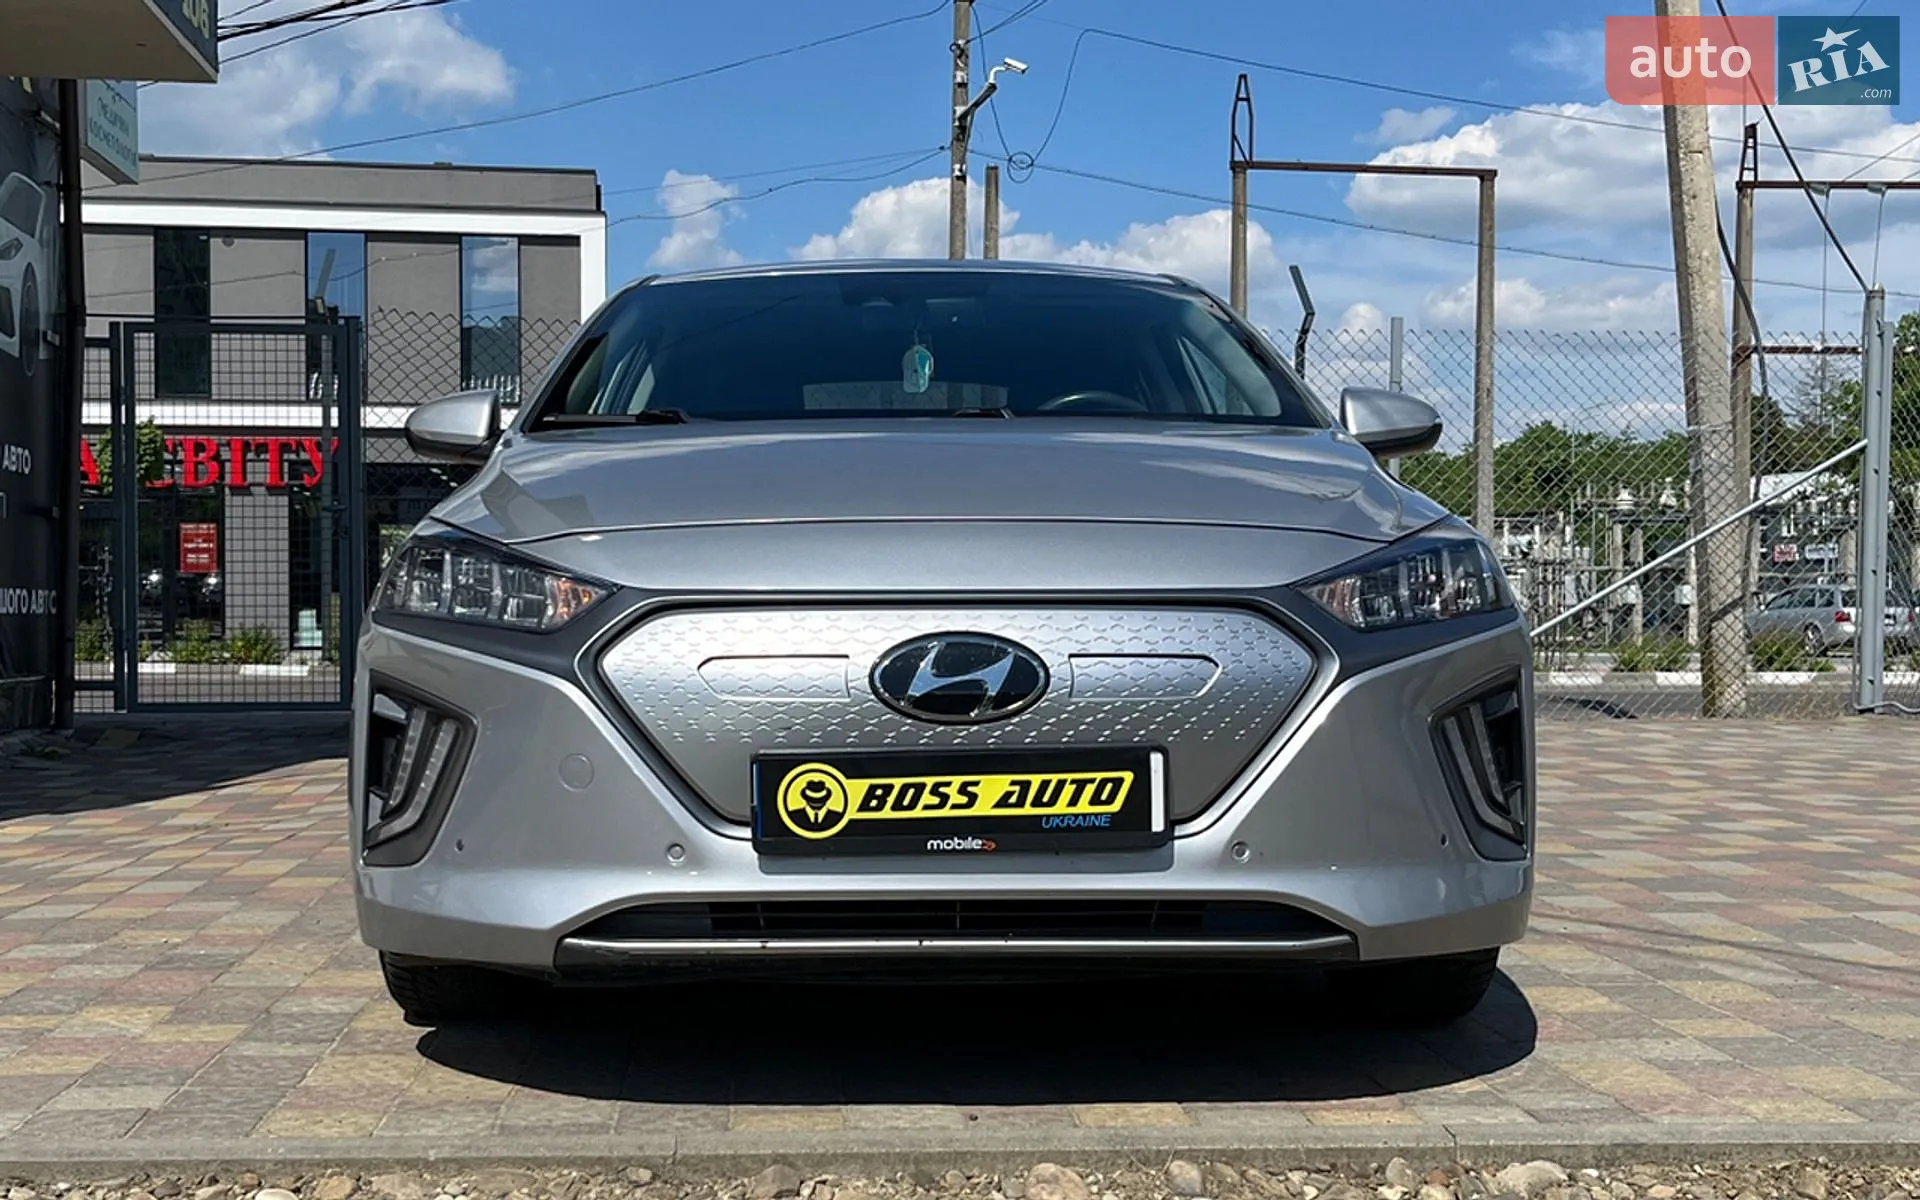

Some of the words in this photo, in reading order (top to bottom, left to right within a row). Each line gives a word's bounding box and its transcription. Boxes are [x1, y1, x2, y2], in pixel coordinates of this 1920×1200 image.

[3, 444, 32, 475] АВТО
[858, 779, 981, 812] BOSS
[992, 777, 1124, 809] AUTO
[1042, 815, 1112, 829] UKRAINE
